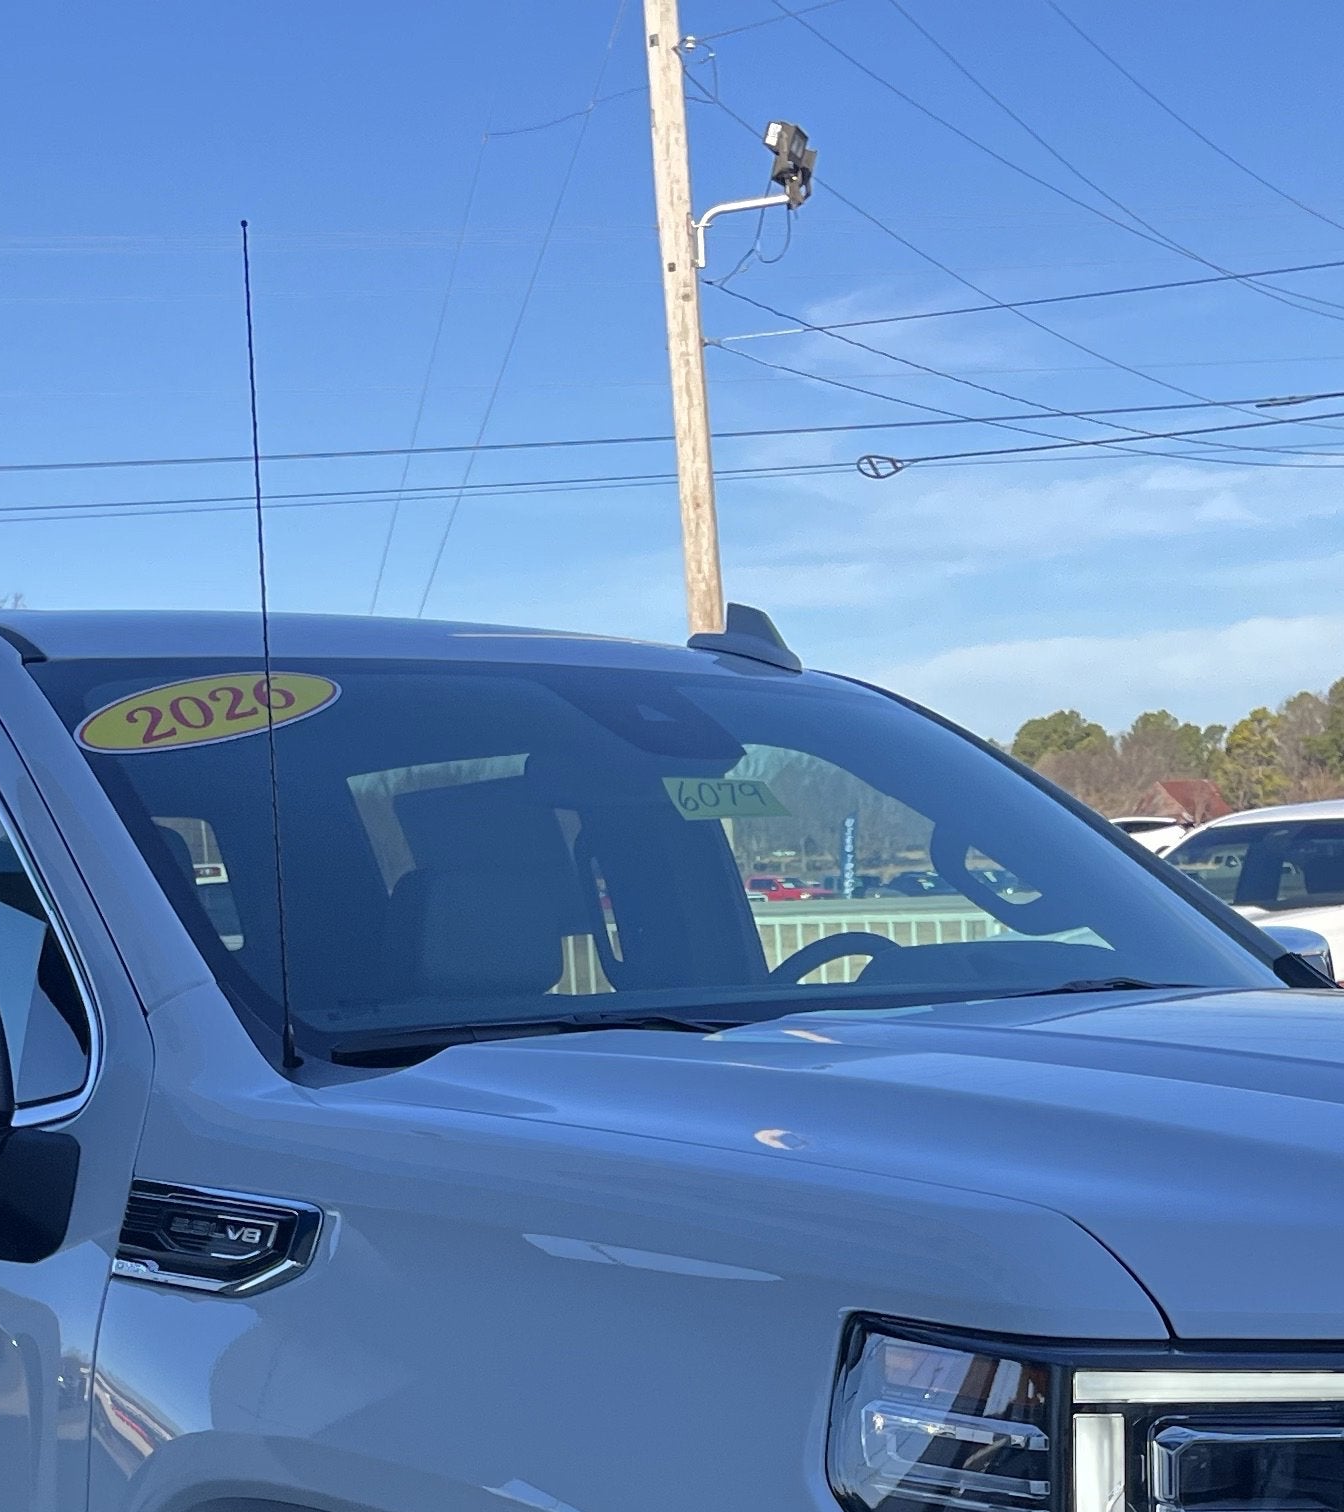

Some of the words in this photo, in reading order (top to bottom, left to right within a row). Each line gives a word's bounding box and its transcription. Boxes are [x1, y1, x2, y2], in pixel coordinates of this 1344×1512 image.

[126, 677, 296, 744] 2026
[677, 780, 767, 812] 6079
[226, 1224, 262, 1244] V8
